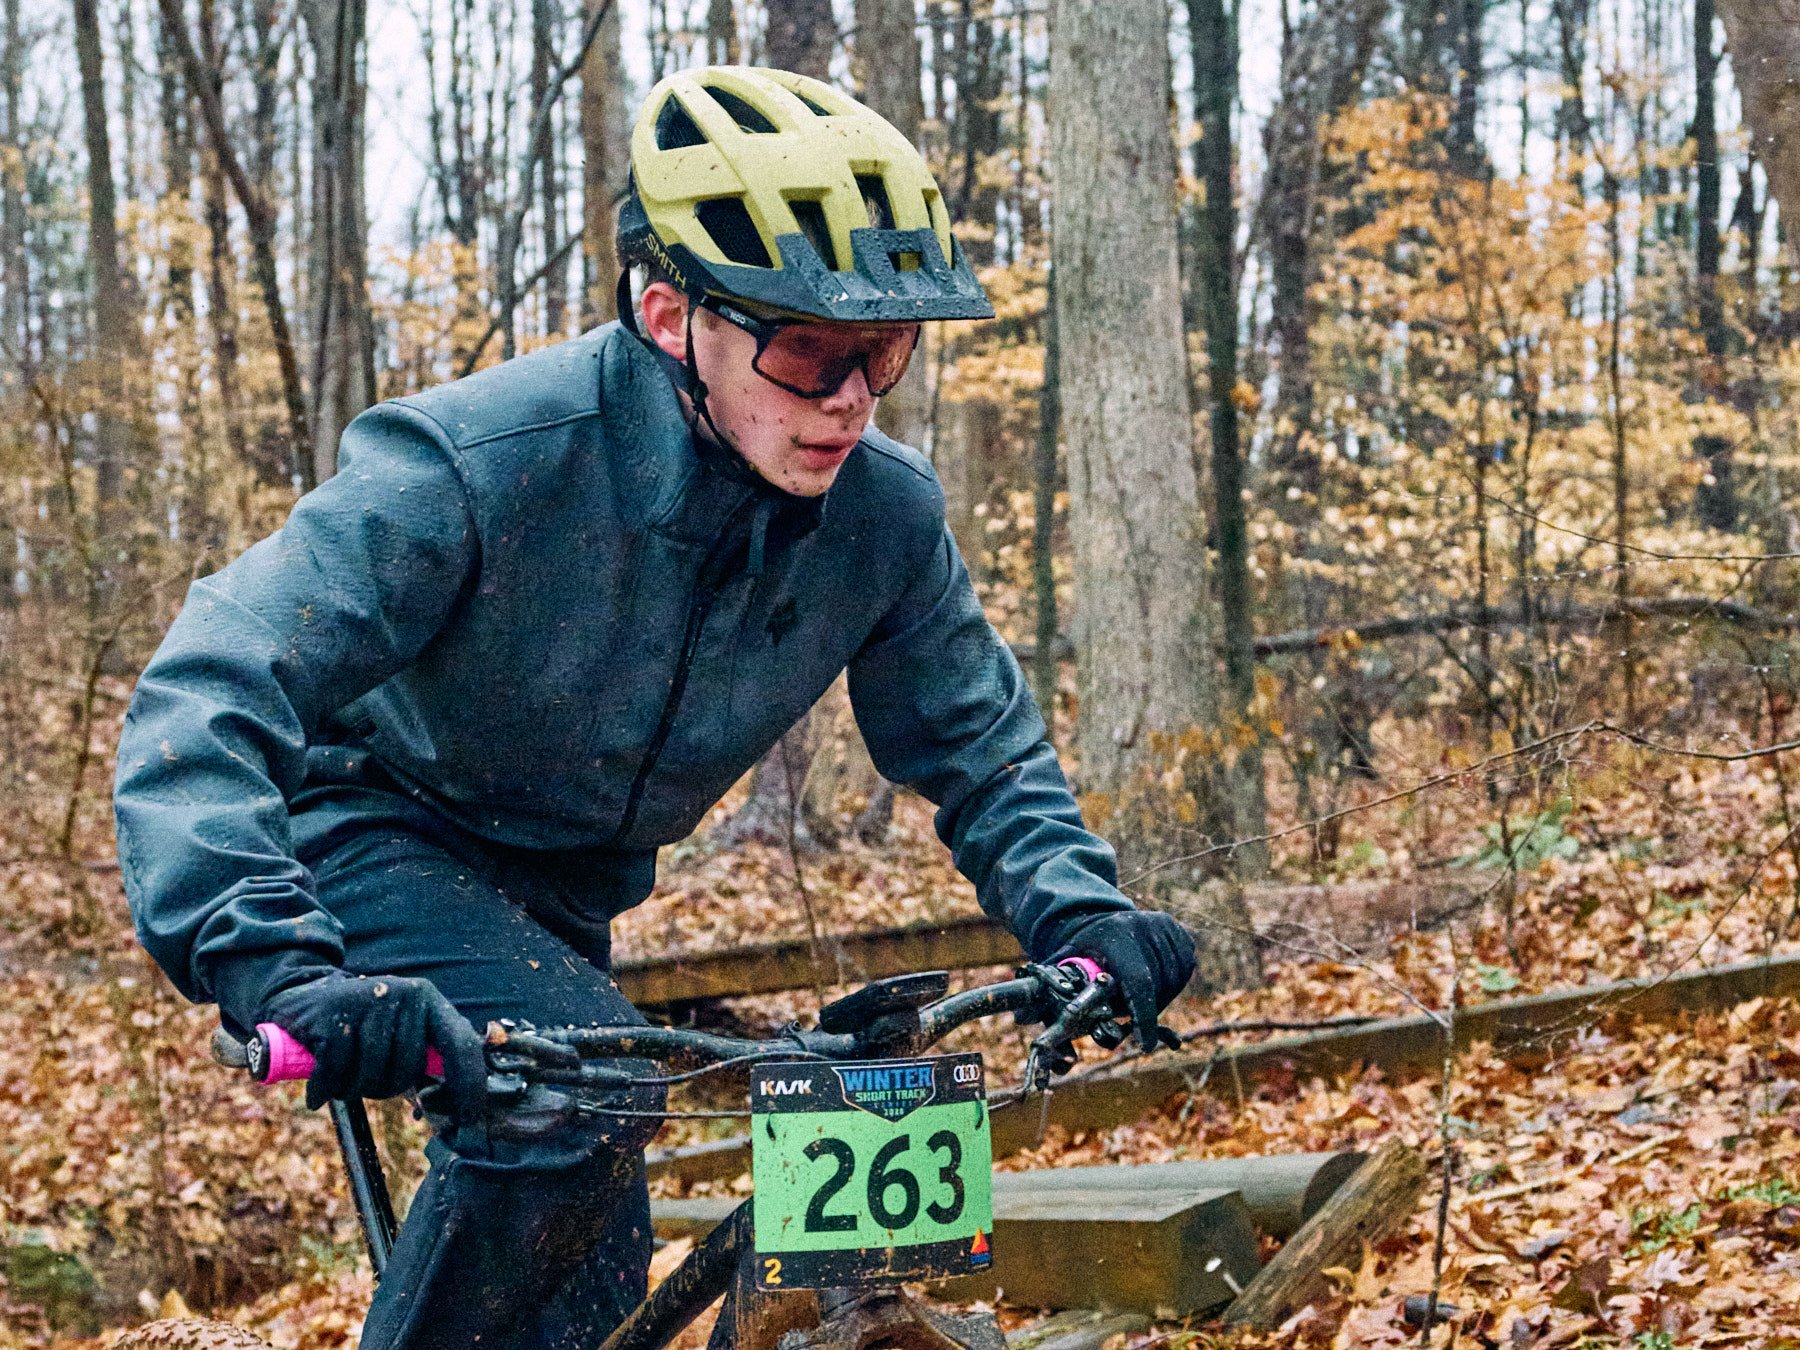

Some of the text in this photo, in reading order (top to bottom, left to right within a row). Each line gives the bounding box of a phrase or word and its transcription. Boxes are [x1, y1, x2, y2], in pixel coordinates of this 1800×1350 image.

[646, 233, 687, 288] SMITH
[843, 1067, 932, 1092] WINTER
[855, 1088, 926, 1102] SHORT TRACK
[802, 1129, 966, 1233] 263
[764, 1258, 782, 1284] 2
